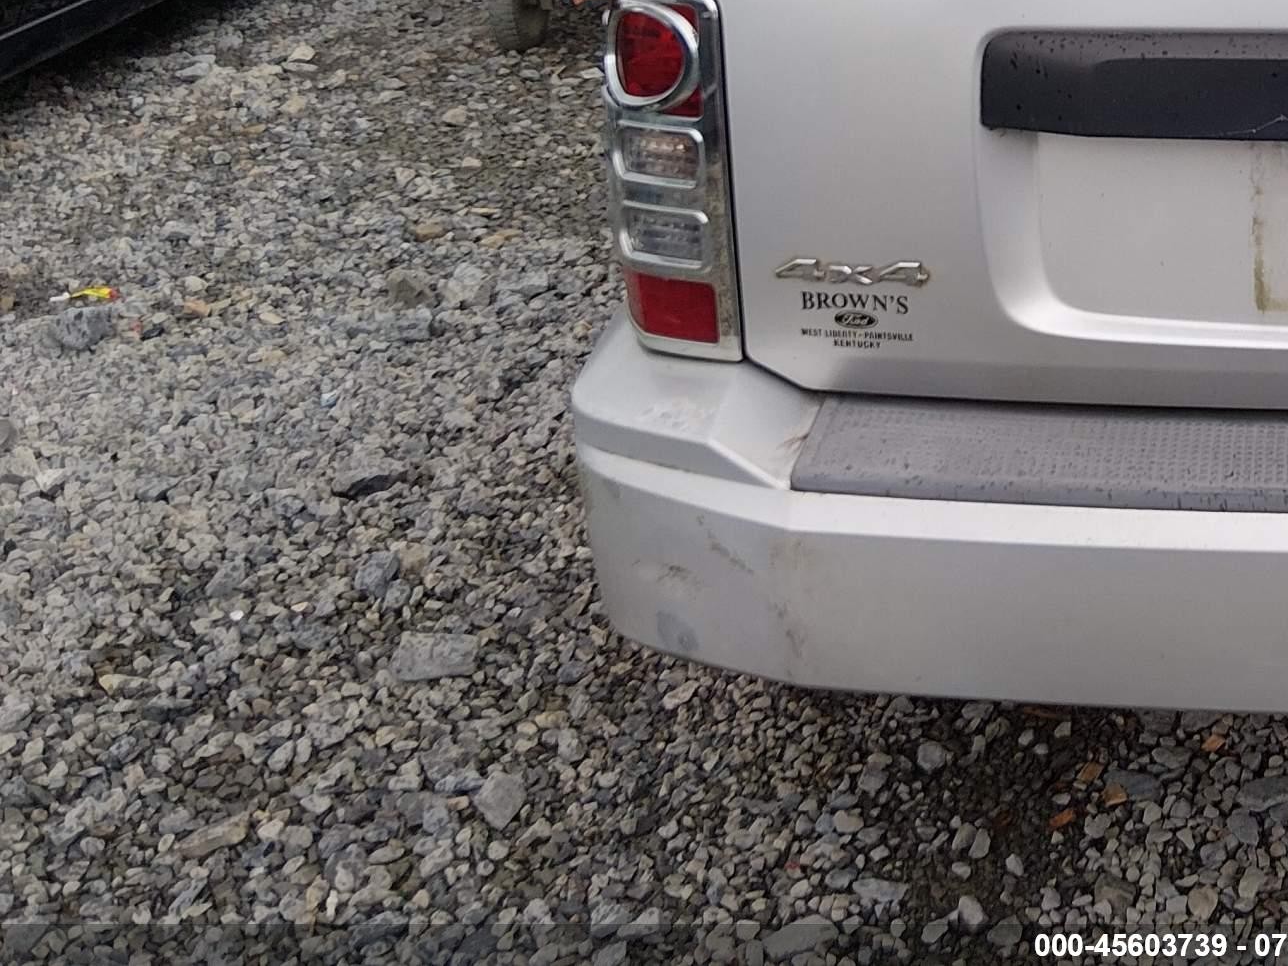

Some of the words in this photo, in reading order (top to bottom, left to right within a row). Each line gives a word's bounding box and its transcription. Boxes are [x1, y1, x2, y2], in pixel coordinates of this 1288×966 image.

[801, 290, 909, 315] BROWN'S
[801, 328, 821, 337] WEST
[825, 329, 858, 339] LIBERTY
[864, 331, 914, 342] PAINTSVILLE
[833, 339, 881, 349] KENTUCKY
